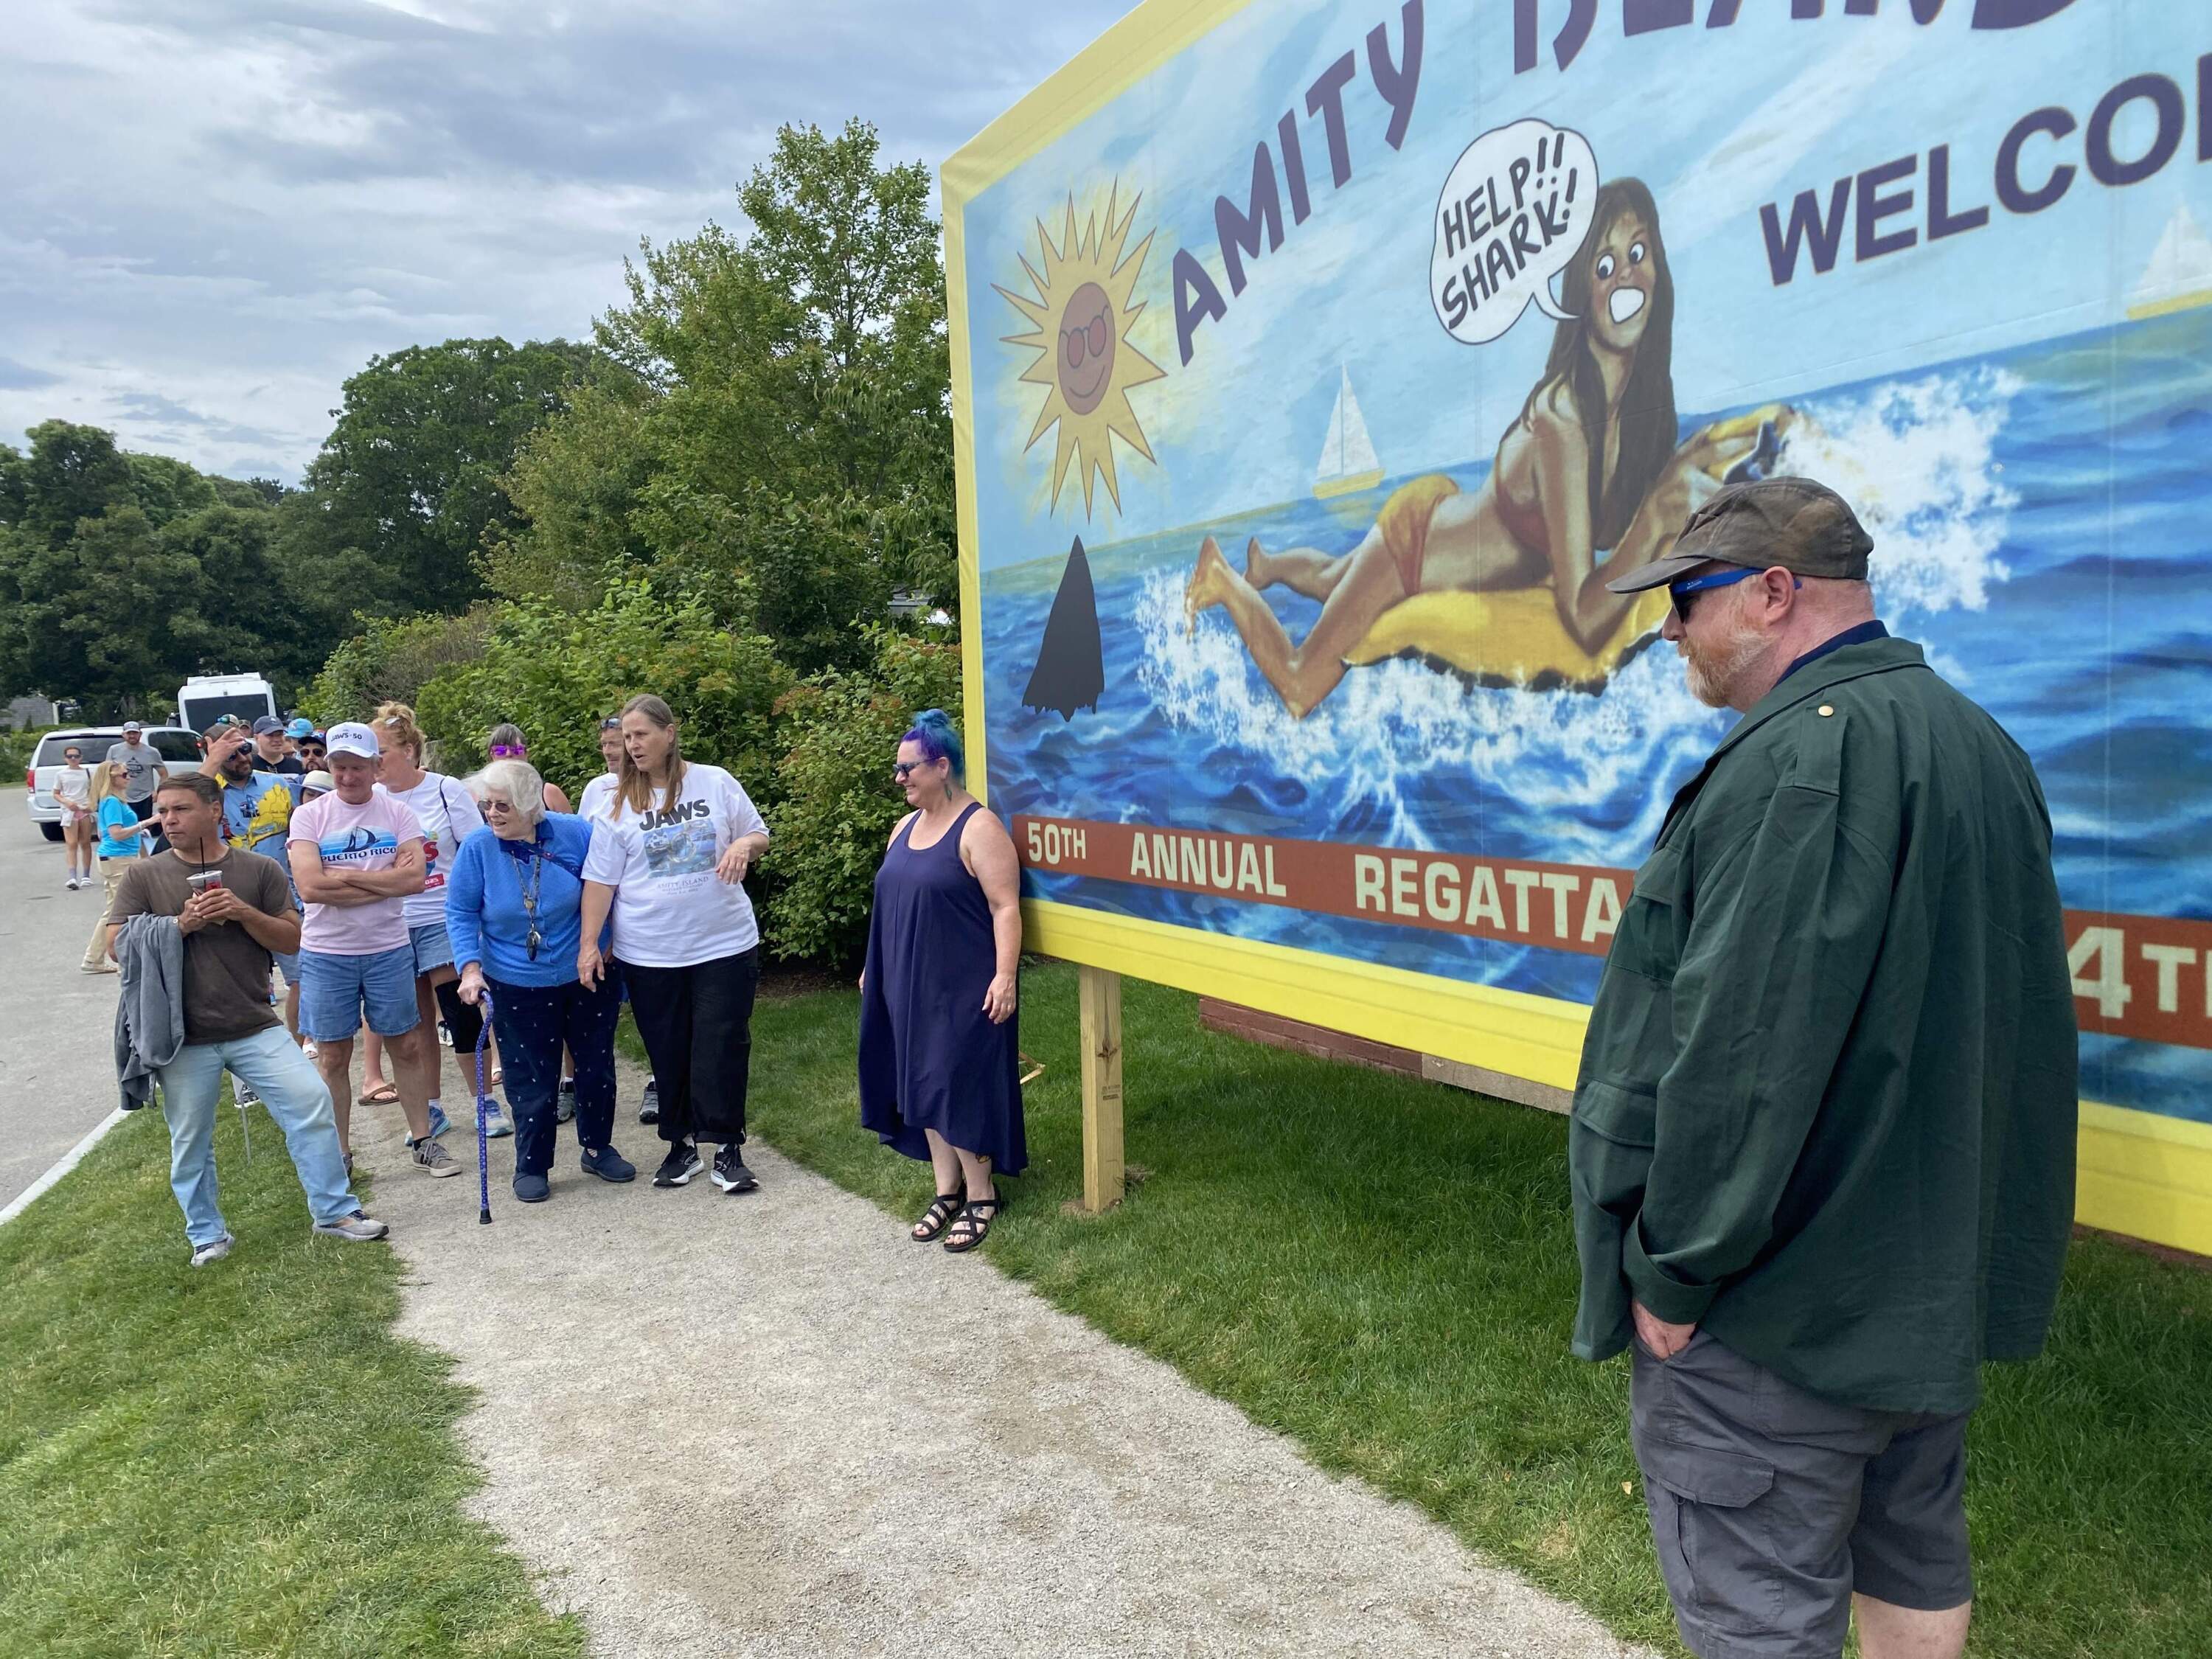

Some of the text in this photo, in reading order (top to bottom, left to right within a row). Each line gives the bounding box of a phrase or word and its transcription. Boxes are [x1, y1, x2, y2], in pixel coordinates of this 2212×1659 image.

[1172, 0, 1425, 367] AMITY
[1441, 167, 1577, 330] SHARK!
[1442, 133, 1565, 259] HELP!!
[1759, 52, 2212, 286] WELCO
[321, 847, 397, 862] PUERTO RICO
[639, 799, 710, 831] JAWS
[1027, 821, 2212, 1019] 50TH ANNUAL REGATTA 4T
